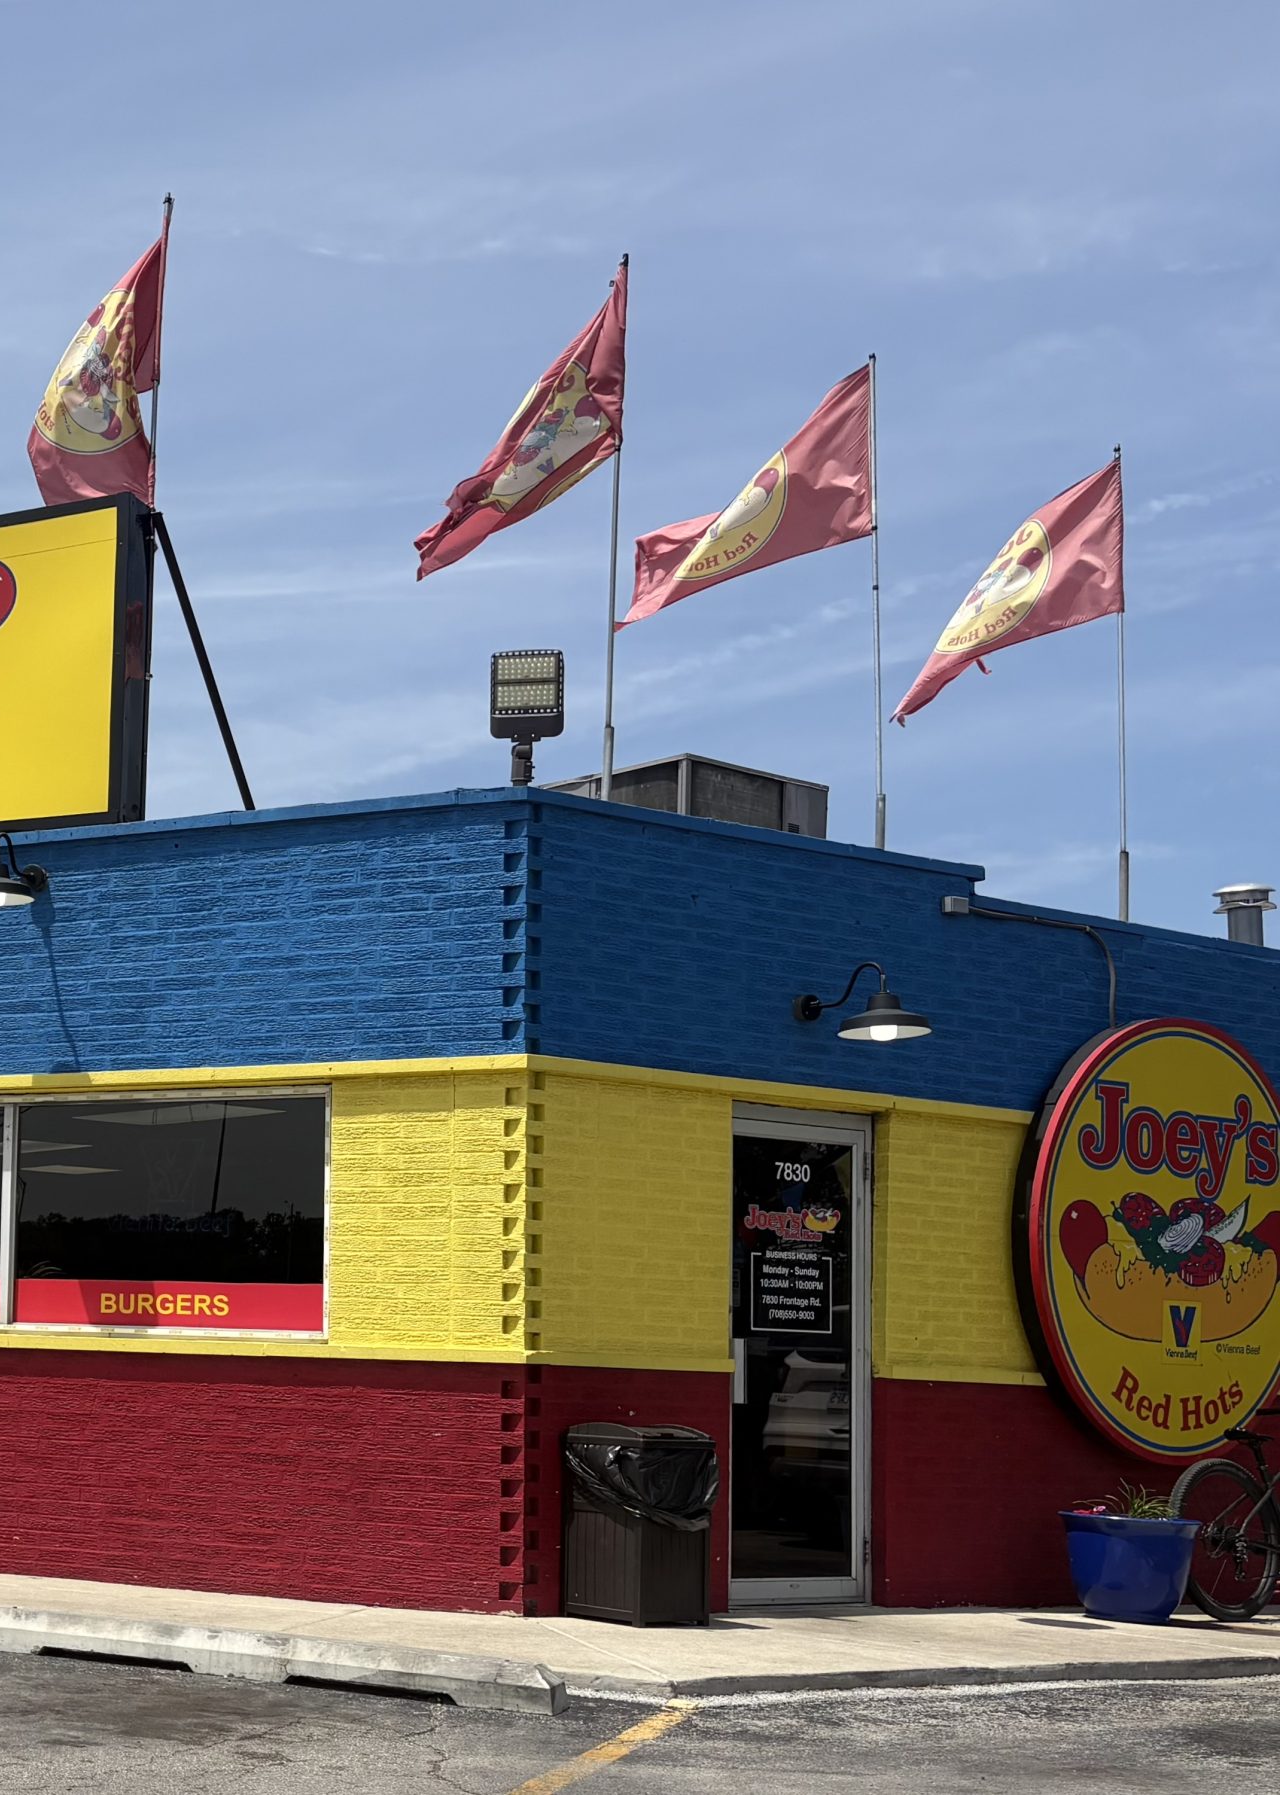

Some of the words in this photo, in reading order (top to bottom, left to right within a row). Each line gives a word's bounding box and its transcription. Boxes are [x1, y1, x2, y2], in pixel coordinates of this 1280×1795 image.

[1078, 1079, 1280, 1203] Joey's
[775, 1162, 811, 1183] 7830
[744, 1203, 801, 1236] Joey's
[766, 1250, 796, 1260] BUSINESS
[797, 1252, 818, 1262] HOURS
[762, 1264, 789, 1277] Monday
[795, 1266, 820, 1278] Sunday
[760, 1278, 789, 1289] 10:30AM
[795, 1279, 824, 1291] 10:00PM
[100, 1292, 230, 1316] BURGERS
[762, 1295, 779, 1305] 7830
[779, 1295, 809, 1307] Frontage
[810, 1297, 822, 1307] Rd.
[1111, 1366, 1172, 1430] Red
[1179, 1380, 1243, 1431] Hots
